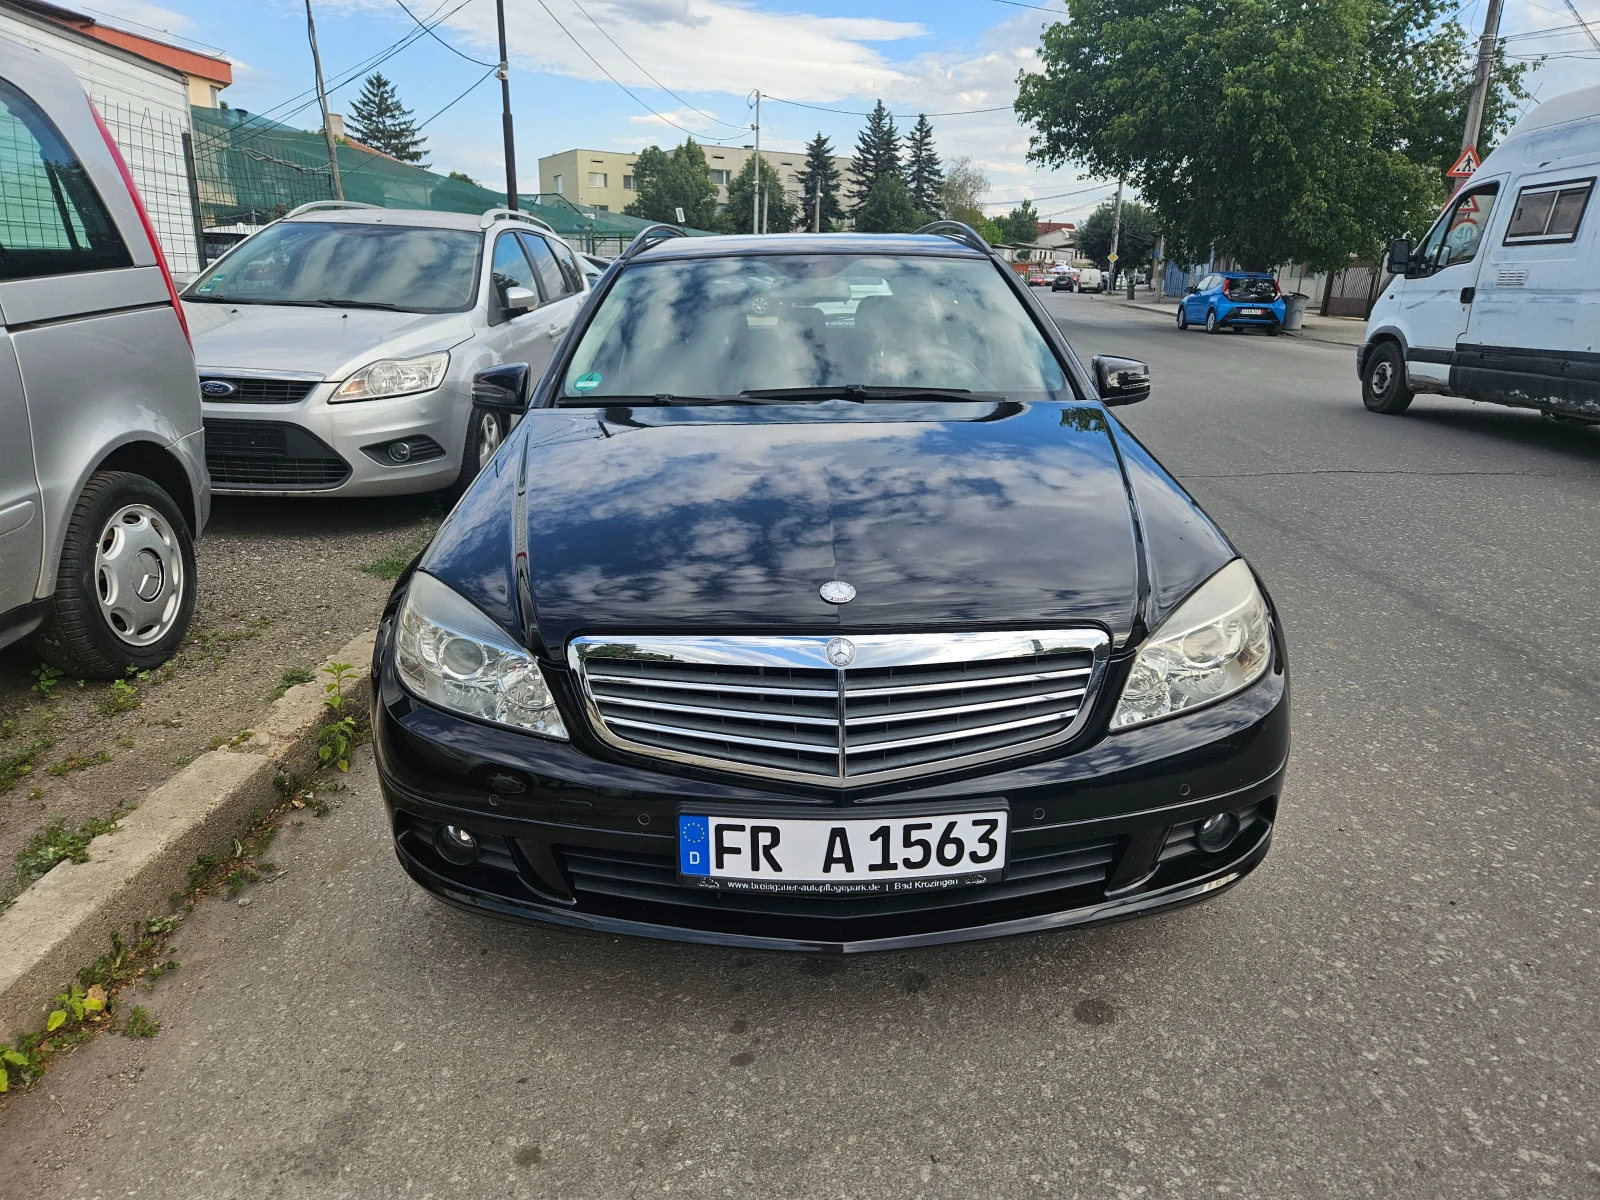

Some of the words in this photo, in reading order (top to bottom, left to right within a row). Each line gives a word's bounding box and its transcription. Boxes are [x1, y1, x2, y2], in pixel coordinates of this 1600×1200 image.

[586, 372, 594, 381] 4
[204, 383, 223, 392] Ford
[714, 824, 783, 873] FR
[822, 827, 855, 873] A
[868, 819, 999, 872] 1563
[689, 851, 700, 865] D
[894, 882, 912, 890] Bad
[914, 878, 959, 889] Krozingen
